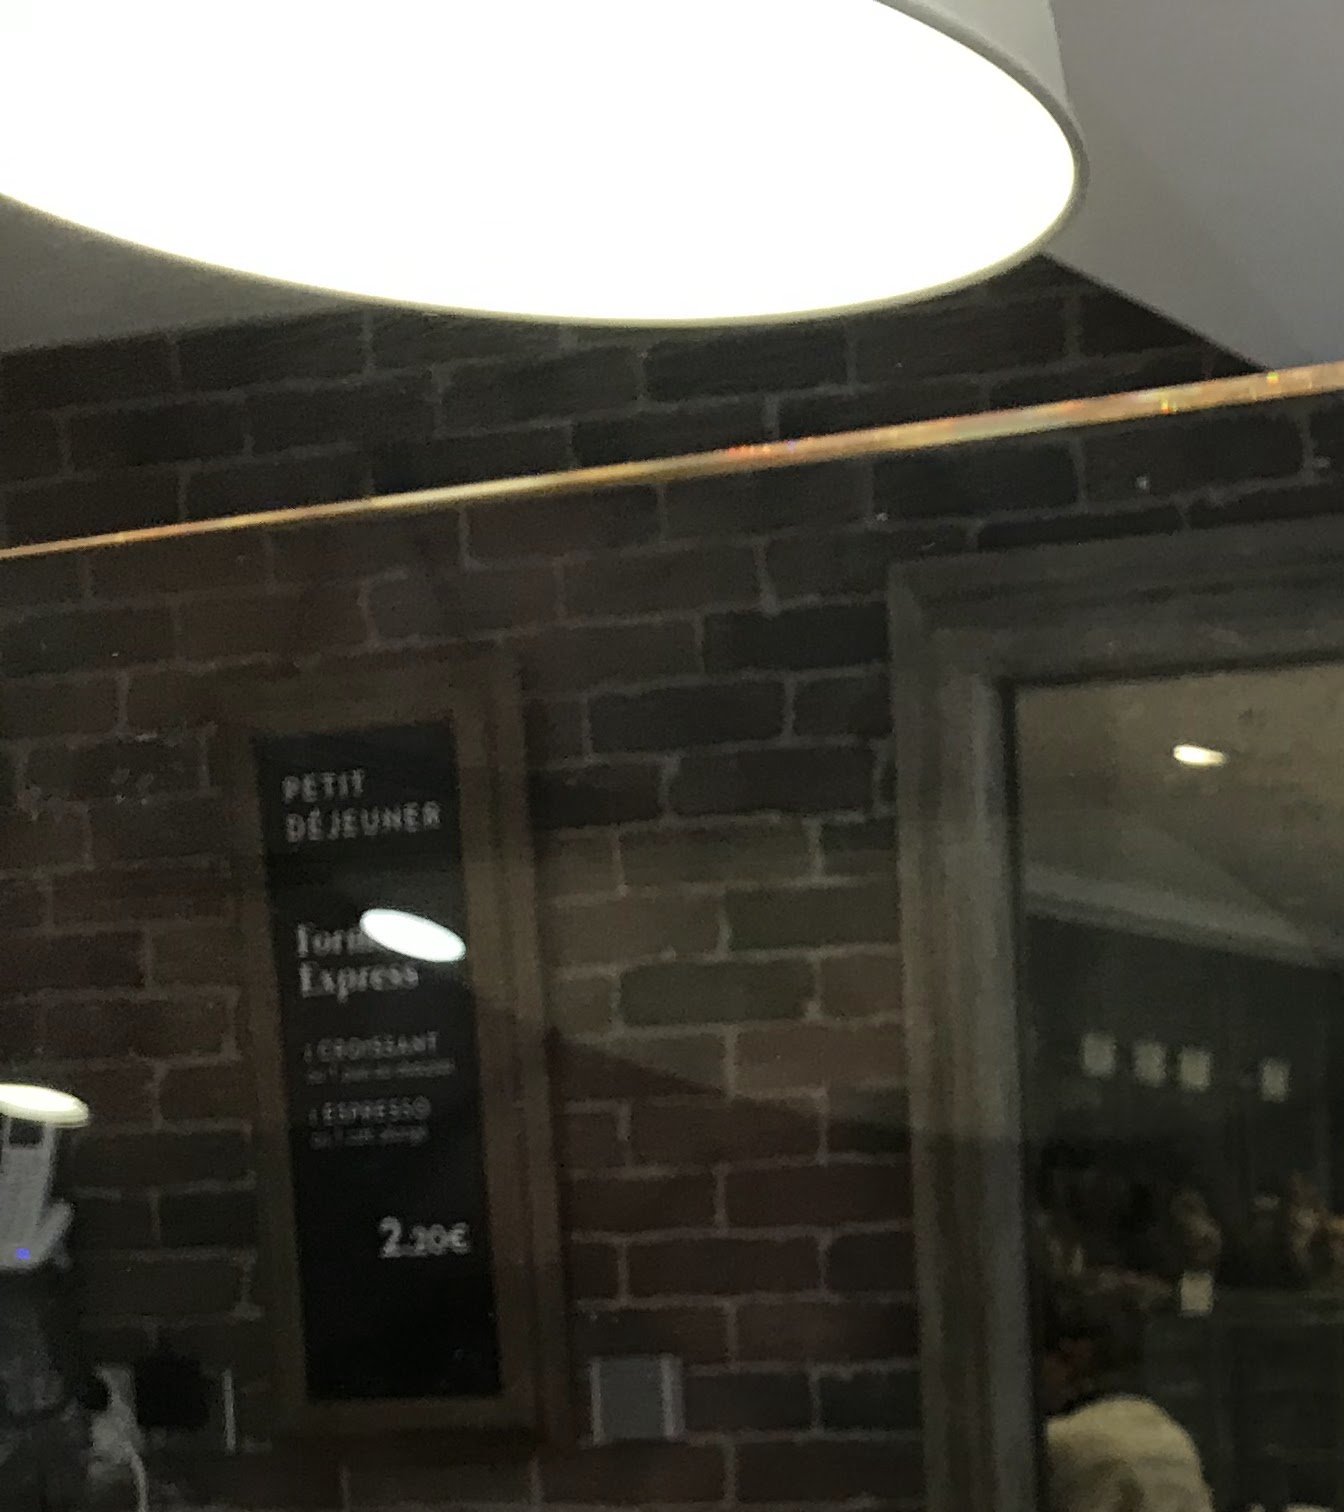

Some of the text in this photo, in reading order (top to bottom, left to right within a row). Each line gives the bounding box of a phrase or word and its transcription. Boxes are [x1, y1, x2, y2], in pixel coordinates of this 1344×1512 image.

[282, 768, 365, 804] PETIT
[285, 801, 441, 843] DÉJEUNER
[299, 960, 420, 1004] Express
